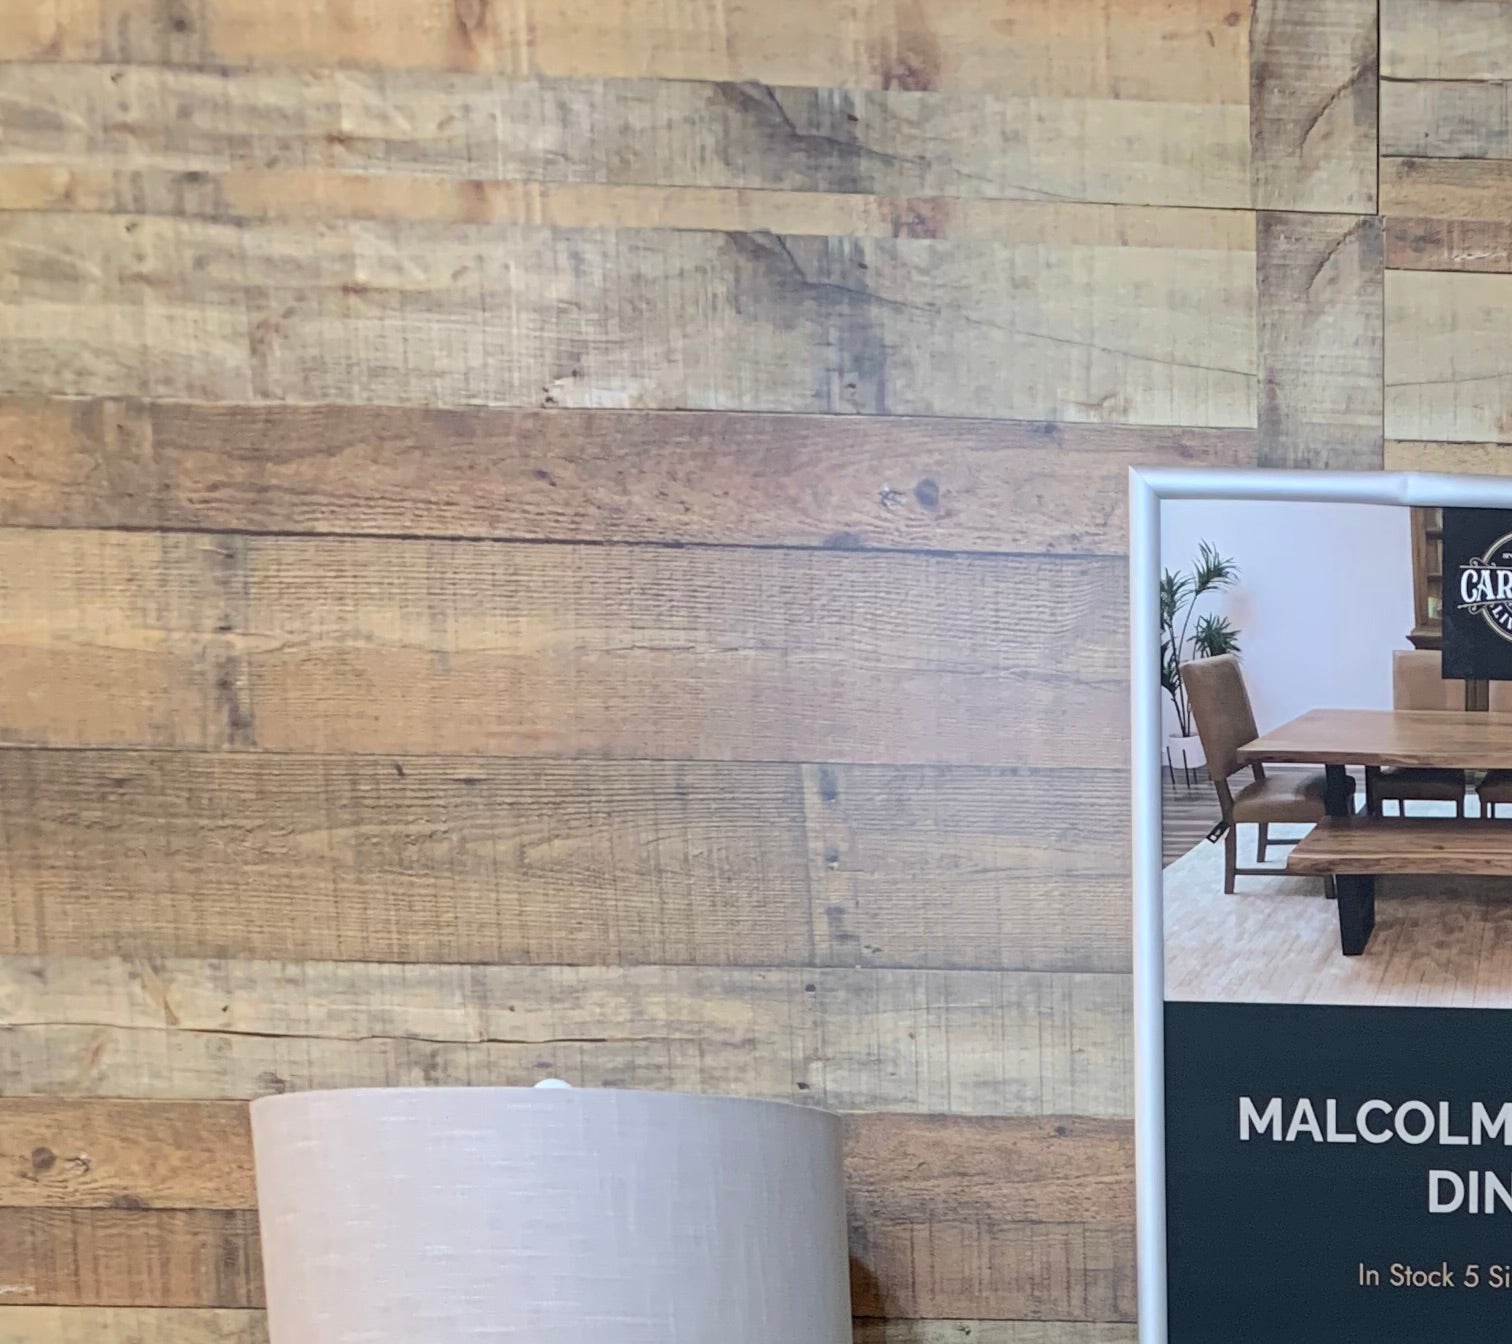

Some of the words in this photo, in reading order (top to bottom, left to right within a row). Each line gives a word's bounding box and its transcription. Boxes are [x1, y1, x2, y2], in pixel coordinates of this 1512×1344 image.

[1357, 1262, 1381, 1287] In
[1389, 1262, 1455, 1288] Stock
[1463, 1264, 1481, 1288] 5
